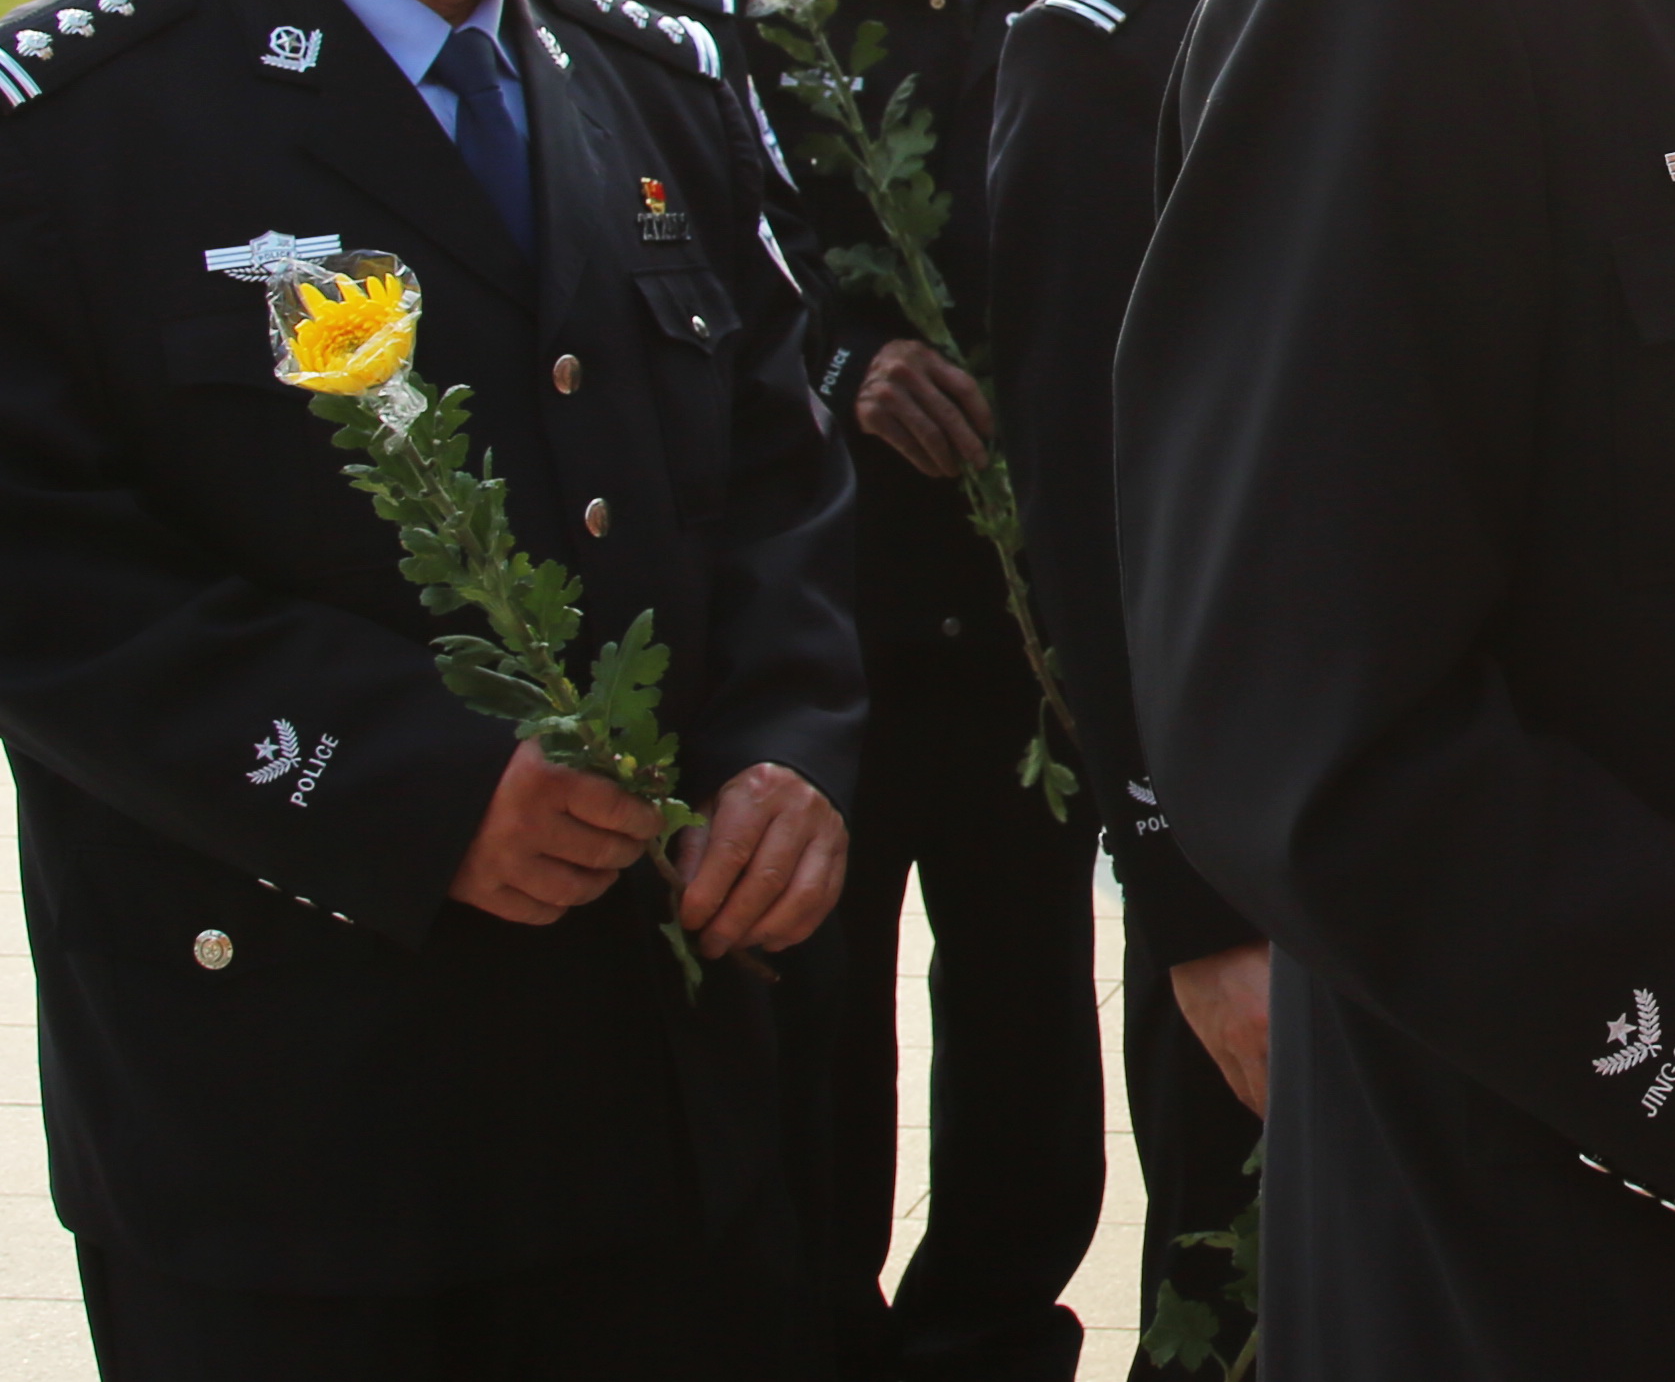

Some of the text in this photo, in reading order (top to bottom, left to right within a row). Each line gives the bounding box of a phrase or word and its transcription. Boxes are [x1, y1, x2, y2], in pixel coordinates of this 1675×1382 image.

[820, 348, 851, 396] POLICE
[290, 733, 339, 807] POLICE
[1136, 814, 1169, 836] POL
